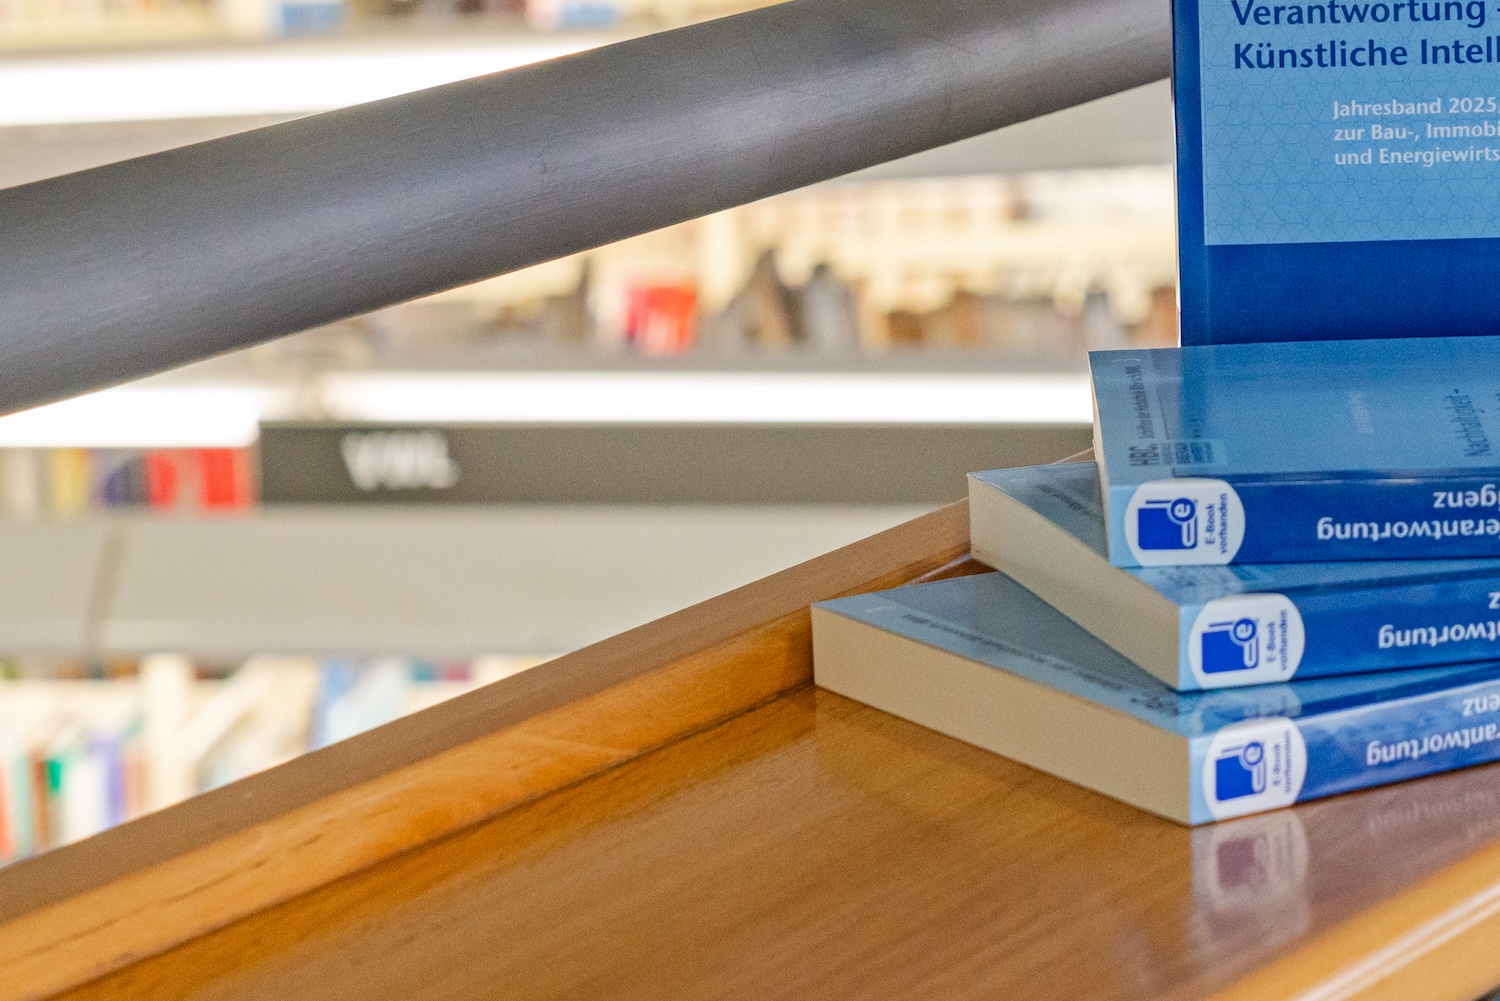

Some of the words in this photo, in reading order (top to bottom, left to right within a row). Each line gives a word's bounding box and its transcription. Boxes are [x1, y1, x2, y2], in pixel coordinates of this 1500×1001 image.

[1234, 38, 1408, 69] Künstliche
[1333, 97, 1442, 121] Jahresband
[1333, 127, 1365, 141] zur
[1371, 124, 1420, 142] Bau-,
[1334, 148, 1373, 165] und
[1205, 503, 1216, 545] E-Book
[1219, 493, 1228, 555] vorhanden
[1266, 621, 1277, 663] E-Book
